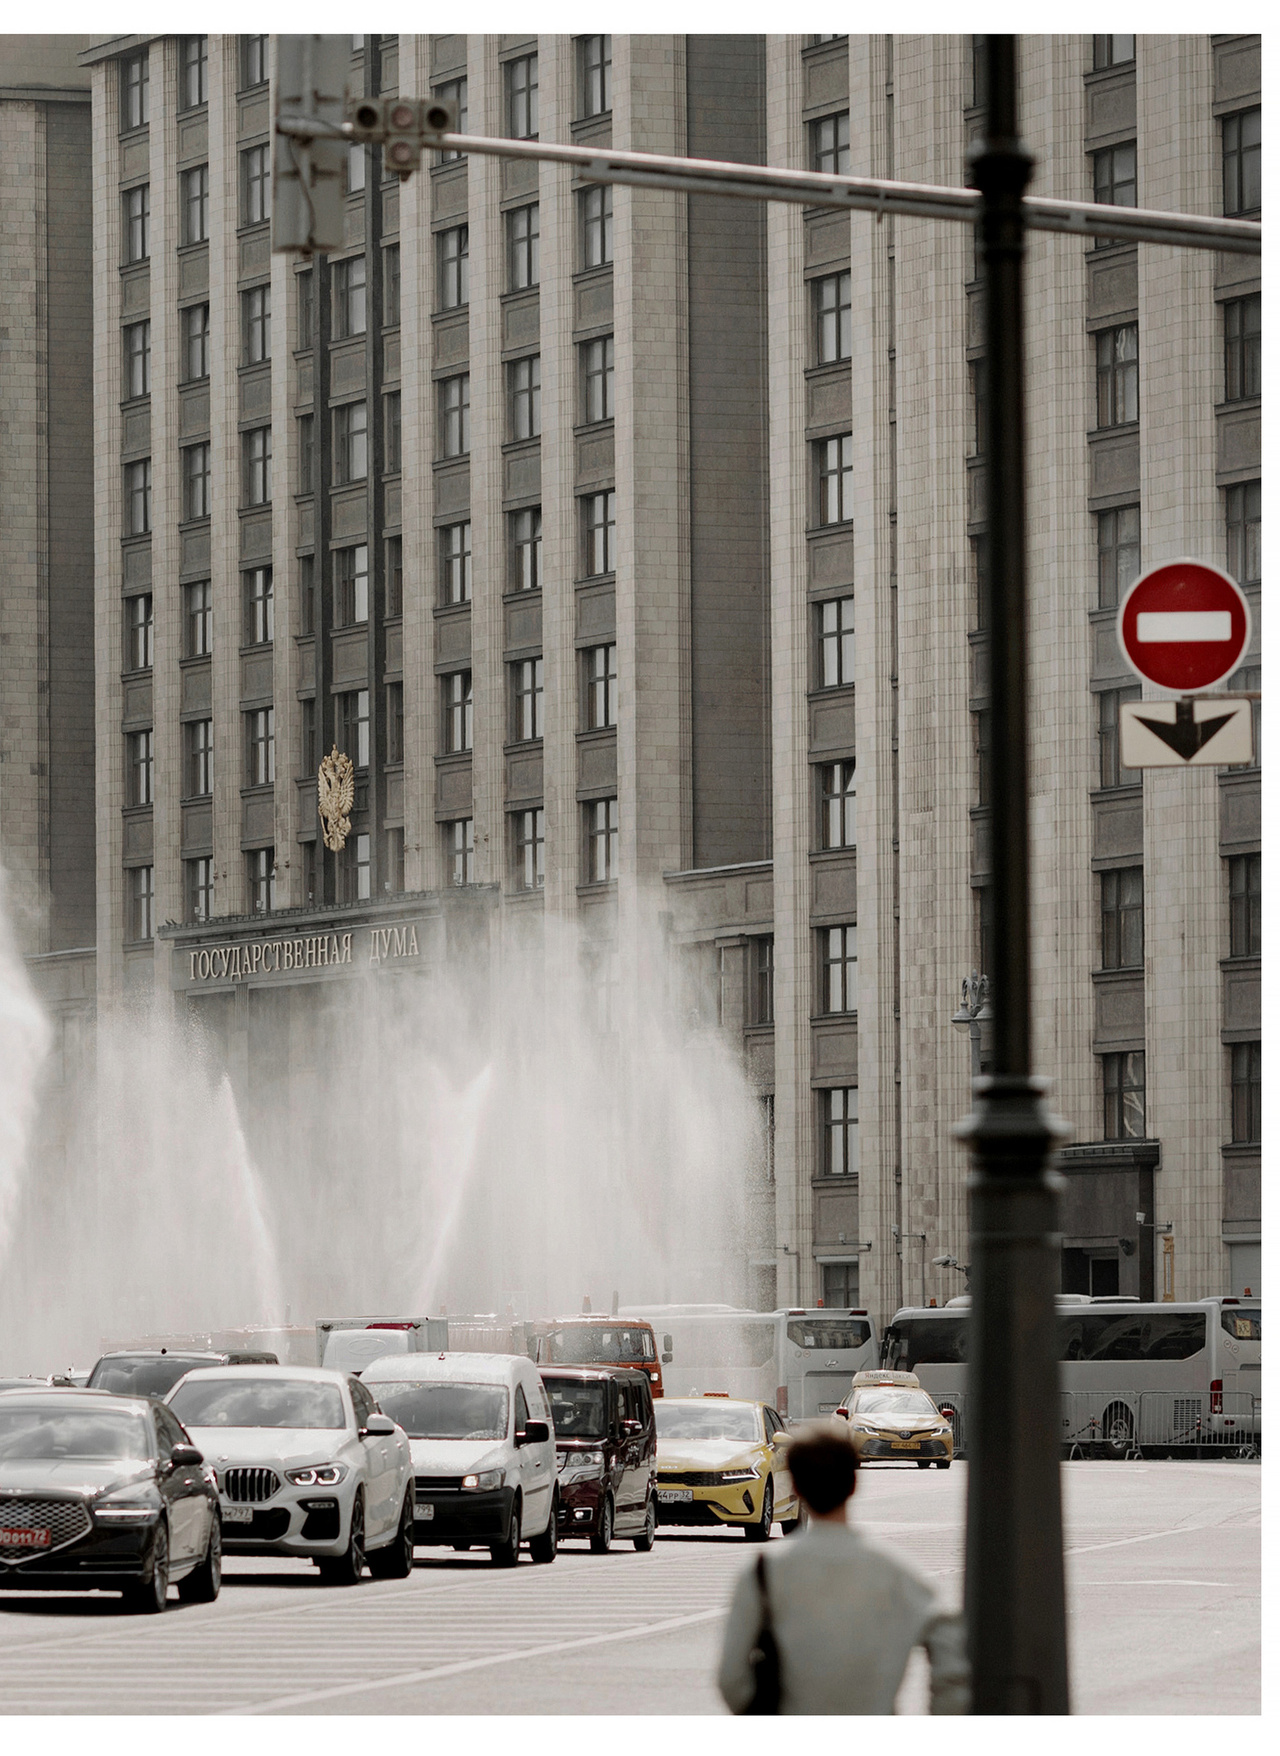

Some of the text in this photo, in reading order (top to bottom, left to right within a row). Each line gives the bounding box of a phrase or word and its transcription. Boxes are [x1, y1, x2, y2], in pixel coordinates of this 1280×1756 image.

[189, 925, 419, 981] ГОСУДАРСТВЕННАЯ ДУМА
[864, 1372, 890, 1380] Яндекс
